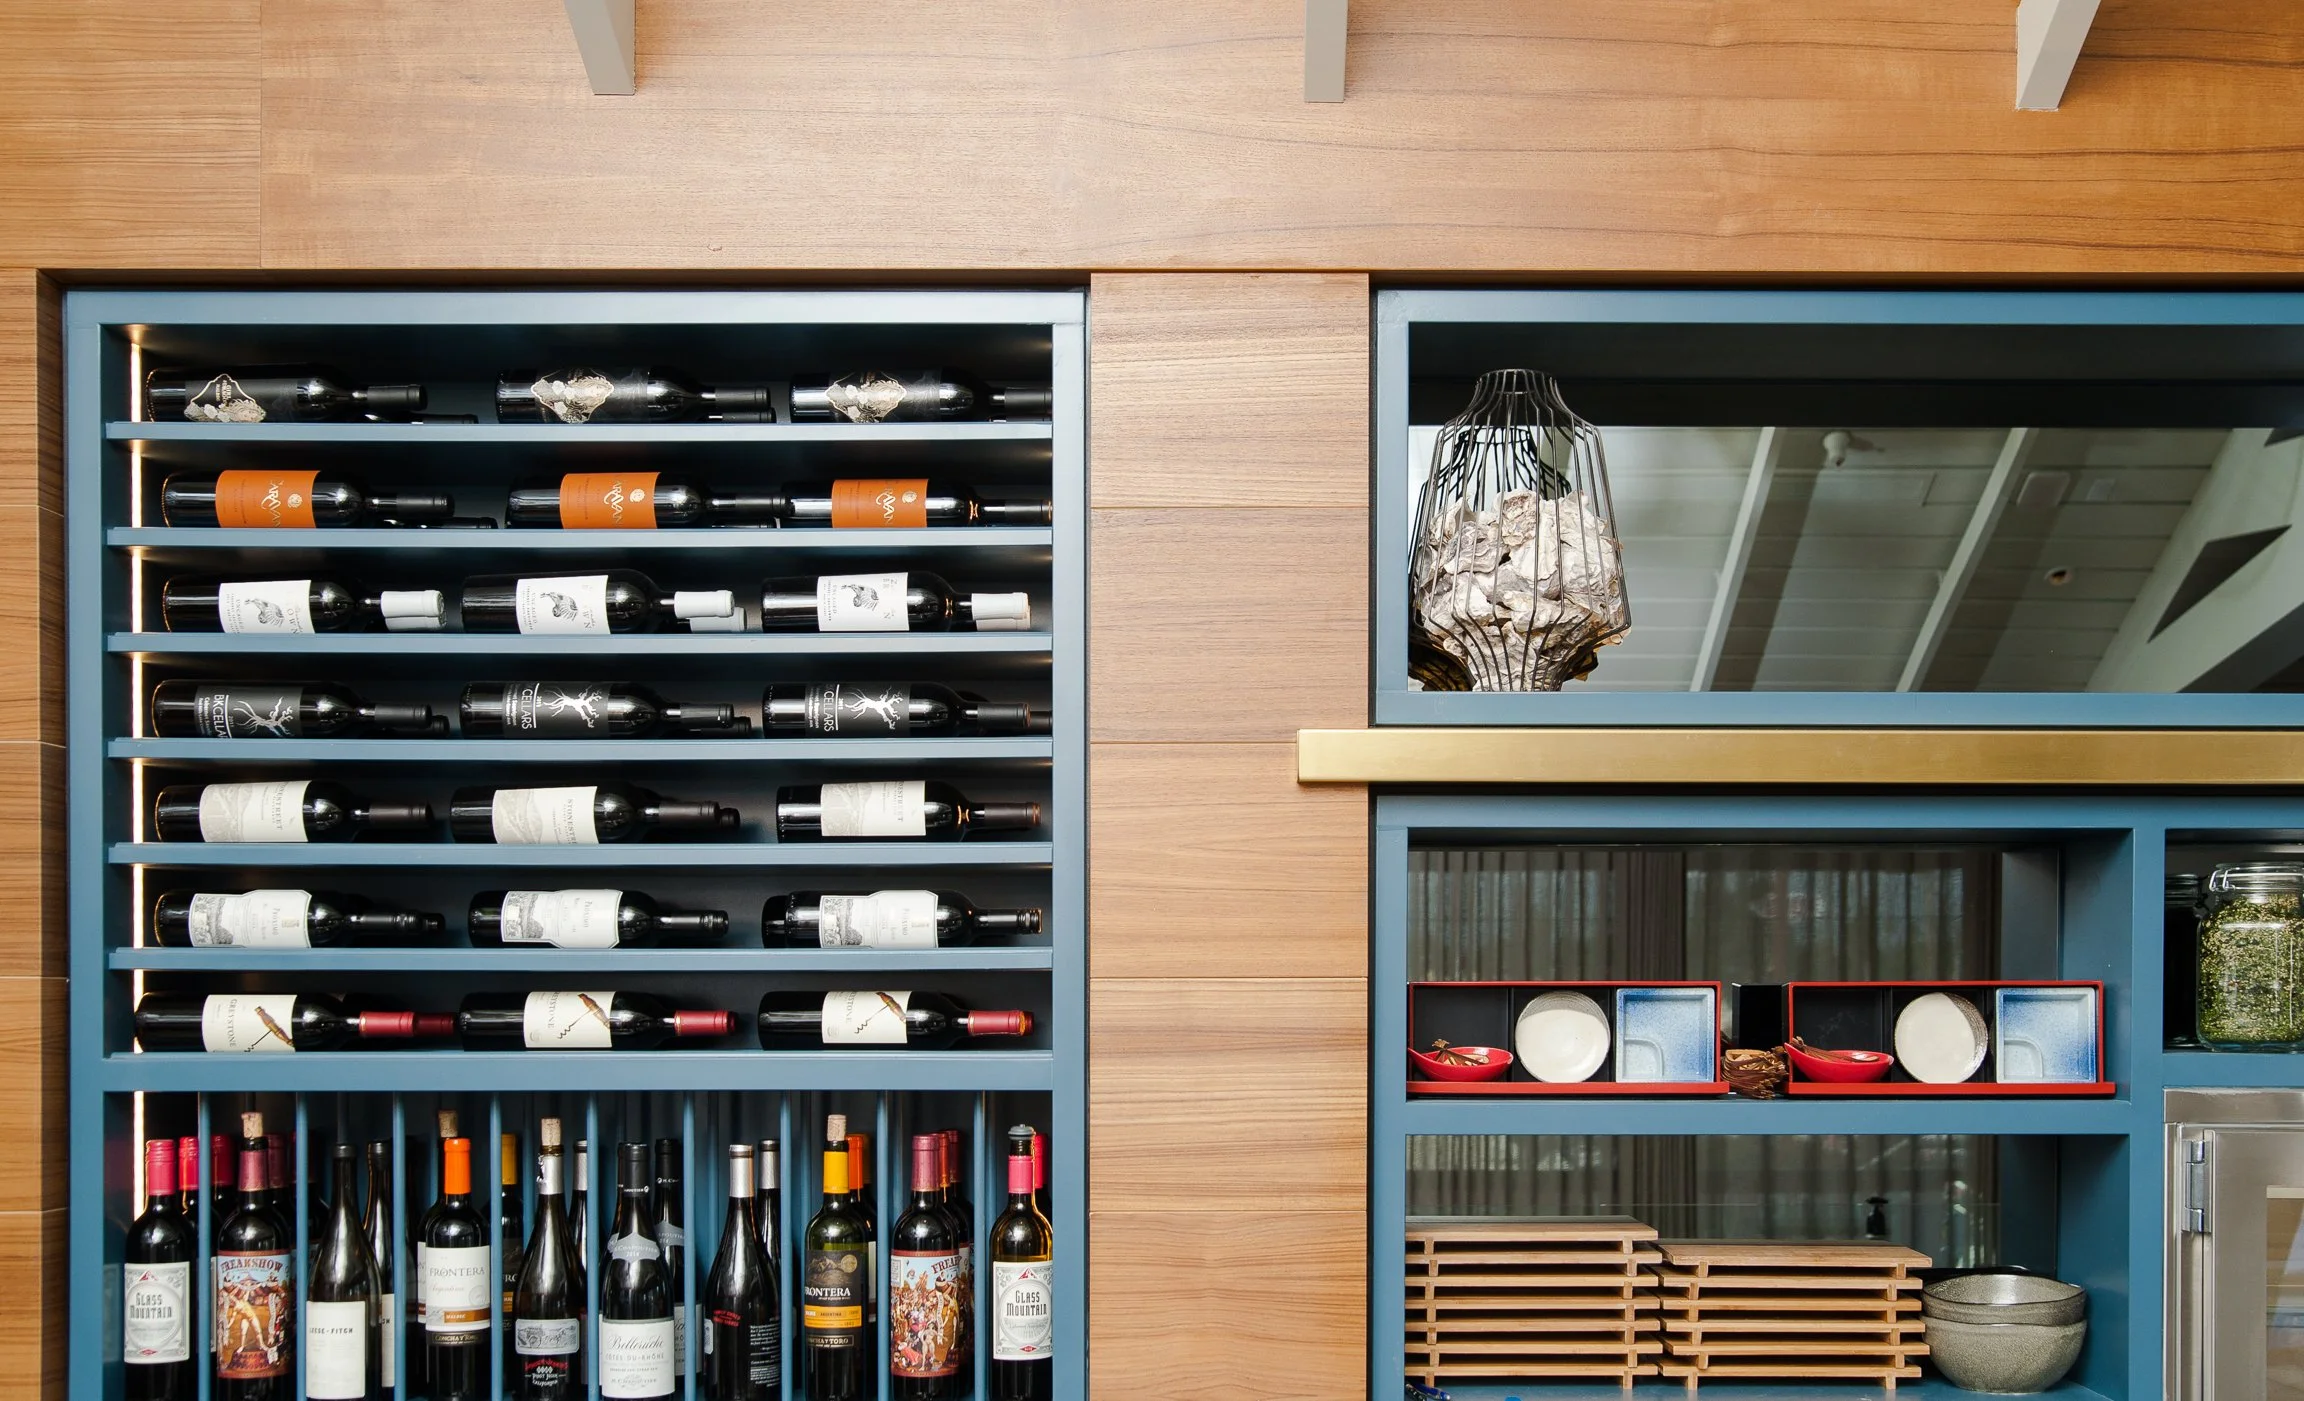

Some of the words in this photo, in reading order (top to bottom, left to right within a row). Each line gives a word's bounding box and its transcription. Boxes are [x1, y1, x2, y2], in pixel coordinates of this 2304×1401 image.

[521, 689, 533, 730] CELLARS
[824, 690, 834, 732] CELLARS
[804, 1286, 851, 1297] RONTERA
[1016, 1290, 1040, 1304] GLASS
[136, 1292, 162, 1306] GLASS
[130, 1305, 172, 1319] MOUNTAIN
[1006, 1302, 1047, 1316] MOUNTAIN
